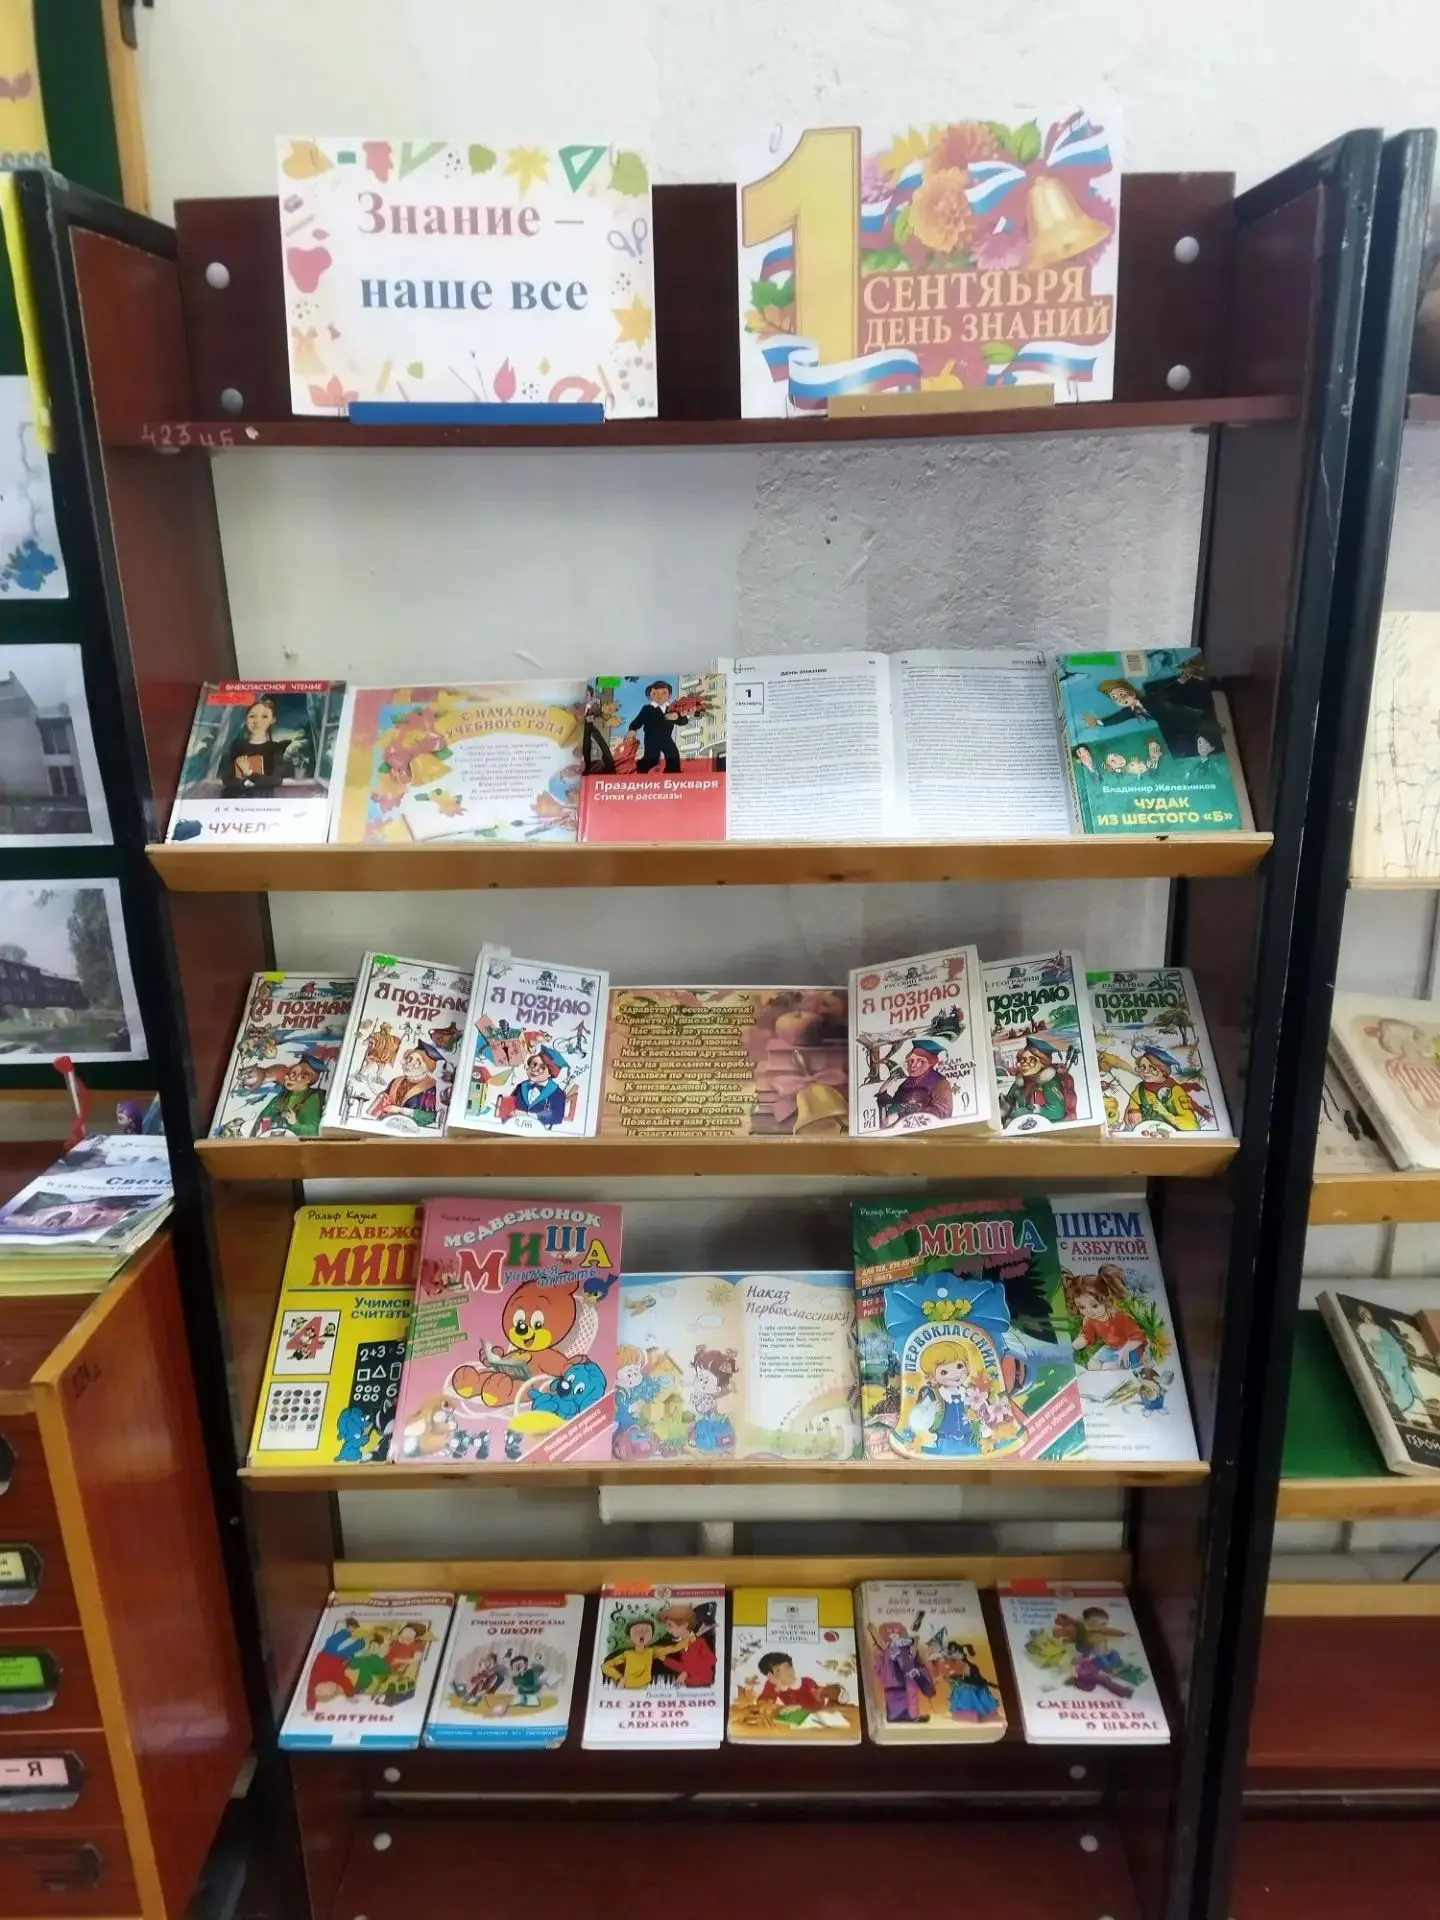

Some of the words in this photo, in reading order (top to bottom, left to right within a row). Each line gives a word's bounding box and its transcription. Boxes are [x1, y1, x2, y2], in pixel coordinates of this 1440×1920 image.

[358, 190, 541, 237] Знание
[742, 126, 861, 366] 1
[360, 277, 493, 311] наше
[511, 278, 589, 311] все
[863, 265, 1088, 314] СЕНТЯБРЯ
[863, 317, 951, 355] ДЕНЬ
[960, 303, 1112, 343] ЗНАНИЙ
[291, 682, 323, 691] ЧТЕНИЕ
[476, 705, 548, 720] НАЧАЛОМ
[445, 719, 523, 739] УЧЕБНОГО
[527, 719, 565, 736] ГОДА
[595, 780, 661, 792] Праздник
[664, 778, 720, 790] Букваря
[1103, 785, 1153, 795] Владимир
[1155, 783, 1217, 793] Железников
[594, 793, 623, 801] Стихи
[627, 793, 634, 801] и
[636, 792, 682, 802] рассказы
[1135, 796, 1190, 810] ЧУДАК
[1097, 813, 1119, 826] ИЗ
[1122, 810, 1200, 825] ШЕСТОГО
[374, 981, 391, 1000] Я
[862, 998, 875, 1014] Я
[881, 983, 961, 1011] ПОЗНАЮ
[986, 985, 1070, 1011] ПОЗНАЮ
[257, 999, 274, 1016] Я
[490, 986, 506, 1005] Я
[511, 990, 592, 1017] ПОЗНАЮ
[1094, 992, 1177, 1008] ПОЗНАЮ
[396, 1004, 442, 1022] МИР
[515, 1007, 560, 1027] МИР
[889, 1004, 931, 1025] МИР
[994, 1005, 1040, 1026] МИР
[1104, 1009, 1149, 1024] МИР
[281, 1015, 326, 1029] МИР
[621, 1049, 639, 1057] Мы
[699, 1050, 748, 1059] друзьями
[713, 1059, 756, 1069] корабле
[713, 1070, 753, 1079] Знаний
[624, 1082, 634, 1091] К
[607, 1093, 625, 1102] Мы
[621, 1106, 642, 1114] Всю
[622, 1117, 681, 1126] Пожелайте
[683, 1118, 703, 1126] нам
[705, 1118, 740, 1127] успеха
[1053, 1212, 1145, 1238] ШЕМ
[918, 1218, 1048, 1257] МИША
[1071, 1238, 1149, 1255] АЗБУКОЙ
[456, 1224, 613, 1293] МИША
[354, 1296, 410, 1309] Учимся
[746, 1285, 791, 1304] Наказ
[351, 1308, 410, 1319] считать
[745, 1301, 851, 1326] Первокласснику
[286, 1316, 323, 1360] 4
[904, 1324, 997, 1373] ПЕРВОКЛАССНИК
[487, 1627, 498, 1635] О
[501, 1626, 544, 1635] ШКОЛЕ
[1037, 1700, 1124, 1709] СМЕШНЫЕ
[314, 1712, 394, 1724] Болтуны
[1059, 1711, 1145, 1720] РАССКАЗЫ
[1086, 1721, 1096, 1730] О
[1103, 1721, 1161, 1731] ШКОЛЕ
[28, 1760, 43, 1777] Я
